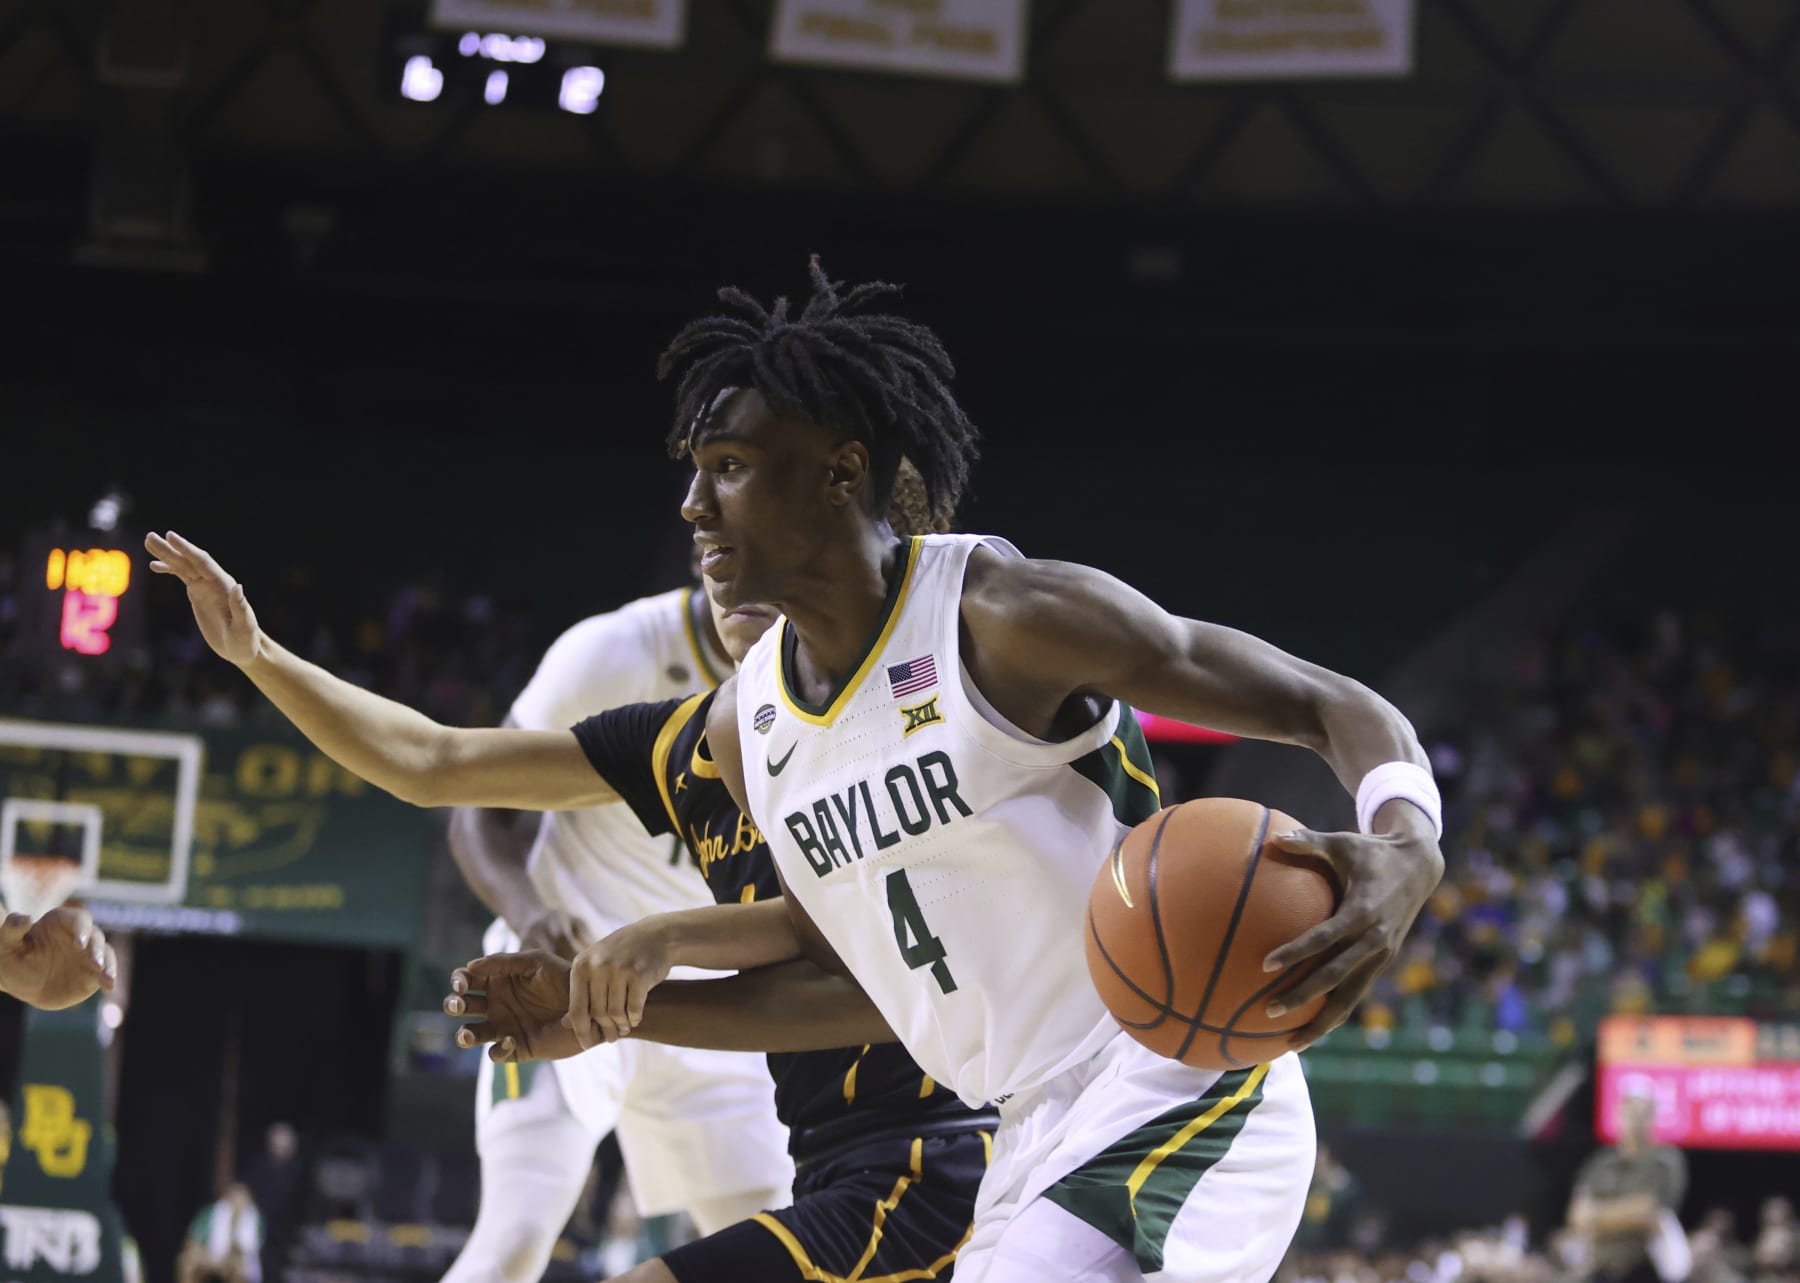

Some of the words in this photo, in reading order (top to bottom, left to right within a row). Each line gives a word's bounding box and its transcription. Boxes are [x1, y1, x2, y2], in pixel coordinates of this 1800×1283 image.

[901, 697, 941, 733] XII
[784, 750, 974, 878] BAYLOR
[886, 867, 958, 995] 4
[20, 1084, 92, 1178] BU
